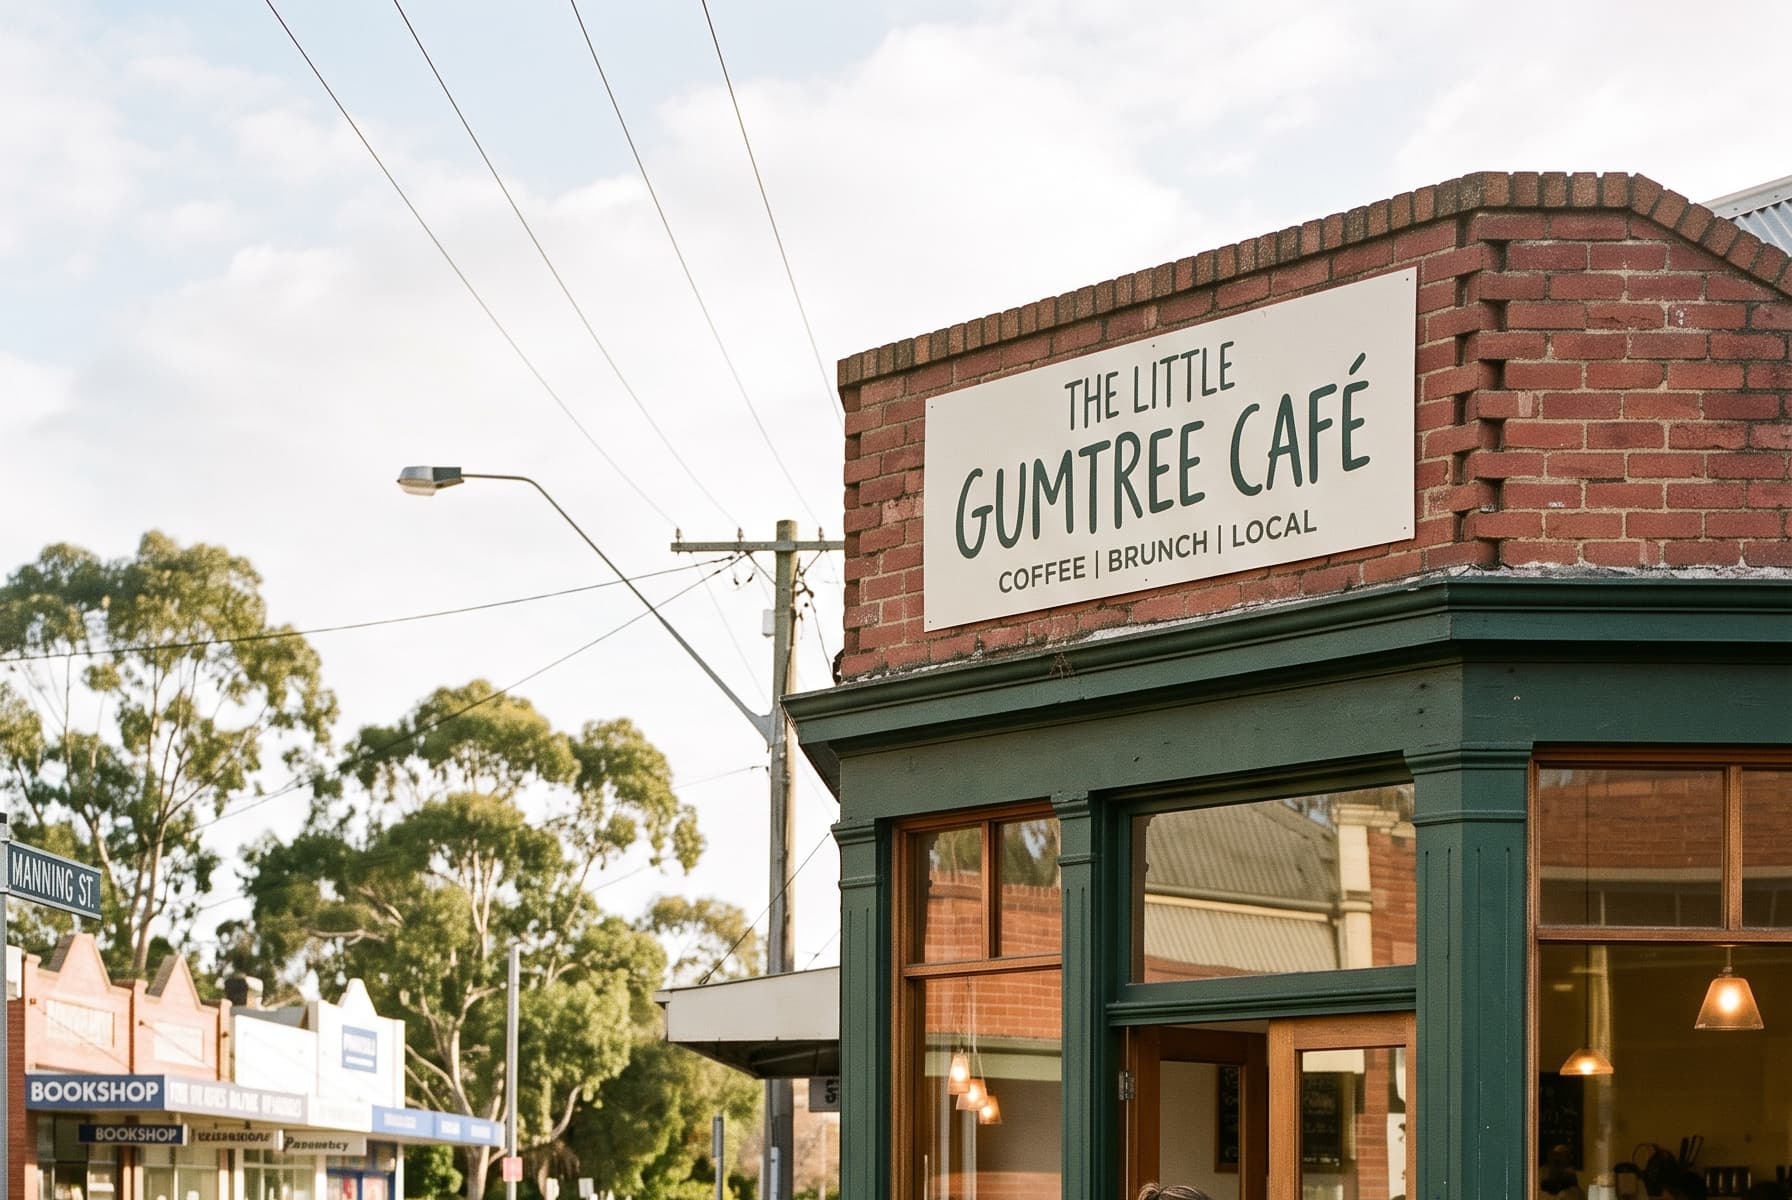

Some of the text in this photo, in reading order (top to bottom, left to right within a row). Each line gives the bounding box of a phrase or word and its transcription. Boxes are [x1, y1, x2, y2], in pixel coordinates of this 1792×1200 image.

[1064, 340, 1236, 431] THE LITTLE
[955, 352, 1372, 560] GUMTREE CAFÉ
[998, 555, 1086, 594] COFFEE
[1108, 529, 1208, 573] BRUNCH
[1232, 509, 1318, 548] LOCAL
[12, 850, 74, 904] MANNING
[31, 1081, 159, 1102] BOOKSHOP
[95, 1127, 177, 1142] BOOKSHOP
